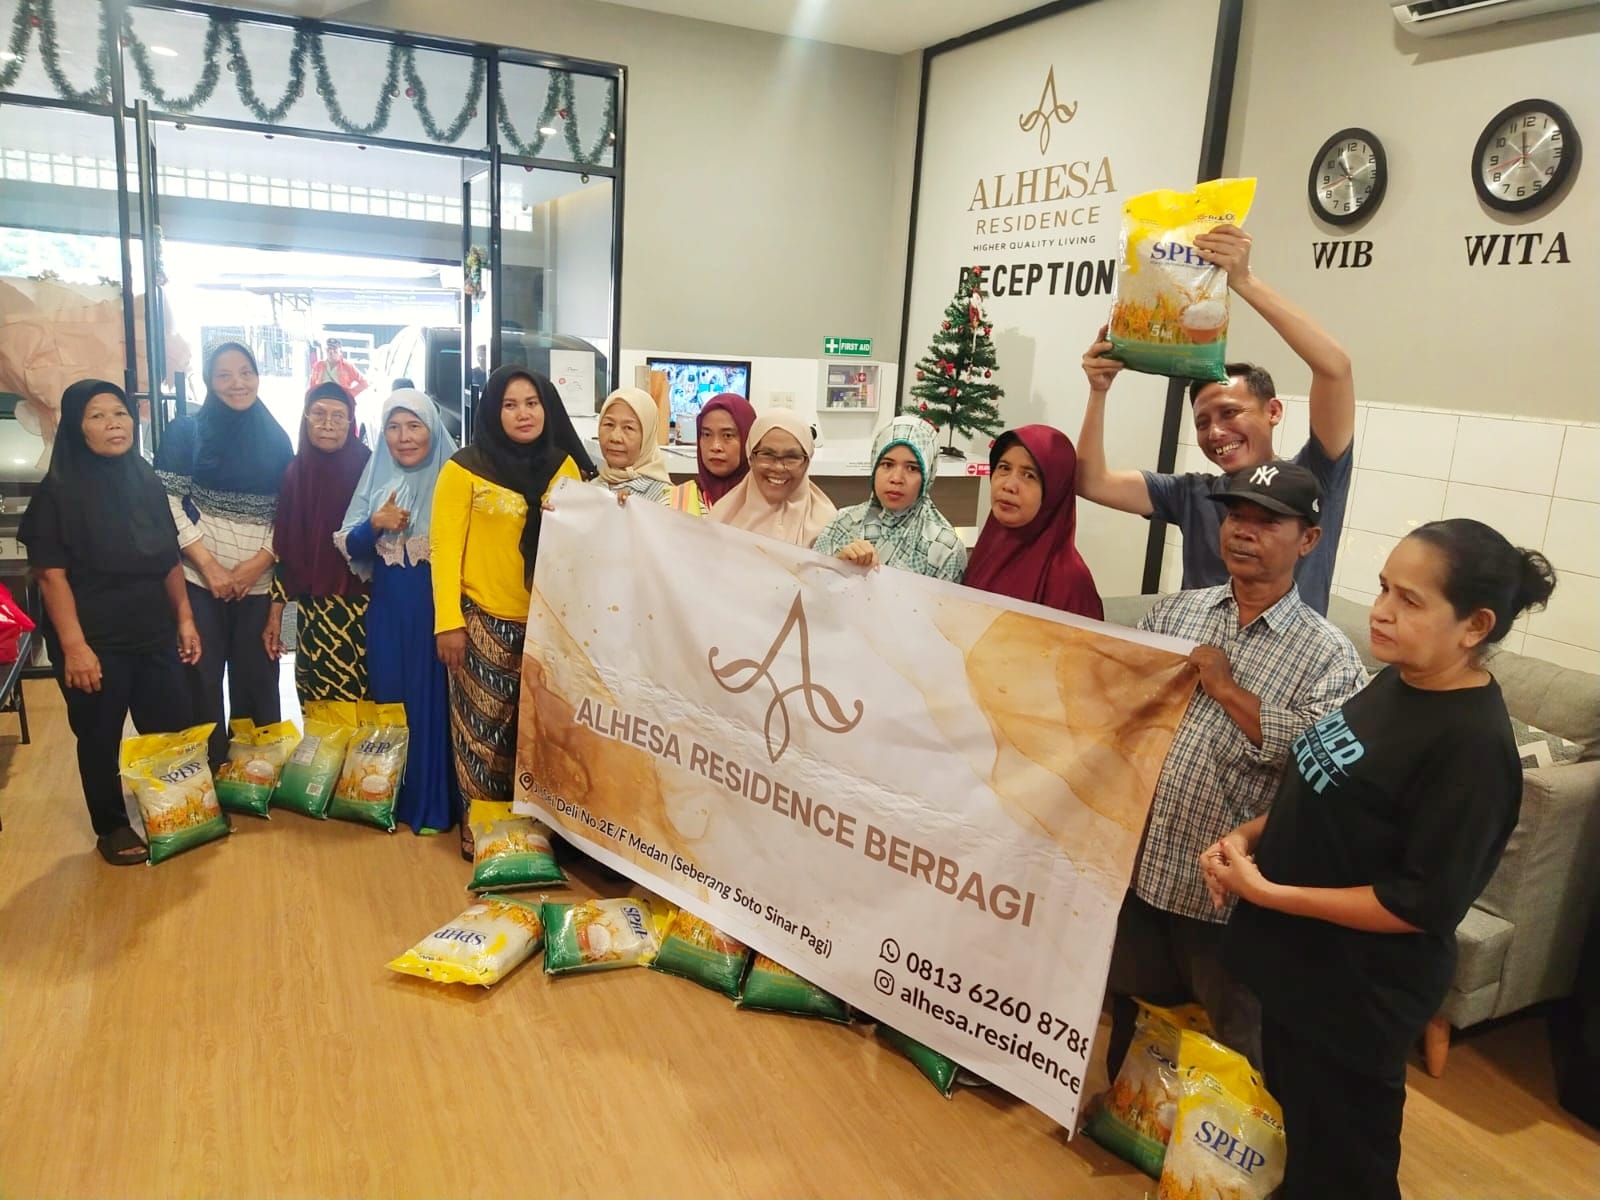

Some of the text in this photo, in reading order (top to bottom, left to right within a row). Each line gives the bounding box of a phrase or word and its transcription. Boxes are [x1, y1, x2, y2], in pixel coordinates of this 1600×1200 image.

[967, 156, 1118, 212] ALHESA
[976, 206, 1101, 235] RESIDENCE
[973, 235, 1096, 252] HIGHER QUALITY LIVING
[1150, 241, 1212, 266] SPH
[1312, 240, 1374, 270] WIB
[1464, 231, 1571, 267] WITA
[841, 342, 870, 352] FIRST AID
[576, 697, 1036, 928] ALHESA RESIDENCE BERBAGI
[556, 798, 578, 819] Deli
[580, 810, 628, 842] No.2E/F
[628, 833, 668, 865] Medan
[671, 854, 732, 900] (Seberang
[733, 888, 762, 915] Soto
[765, 906, 799, 936] Sinar
[800, 925, 833, 959] Pagi)
[433, 928, 488, 946] SPHP
[906, 952, 962, 994] 0813
[968, 983, 1031, 1024] 6260
[900, 986, 1081, 1095] alhesa.residence
[1195, 1120, 1265, 1174] SPHP
